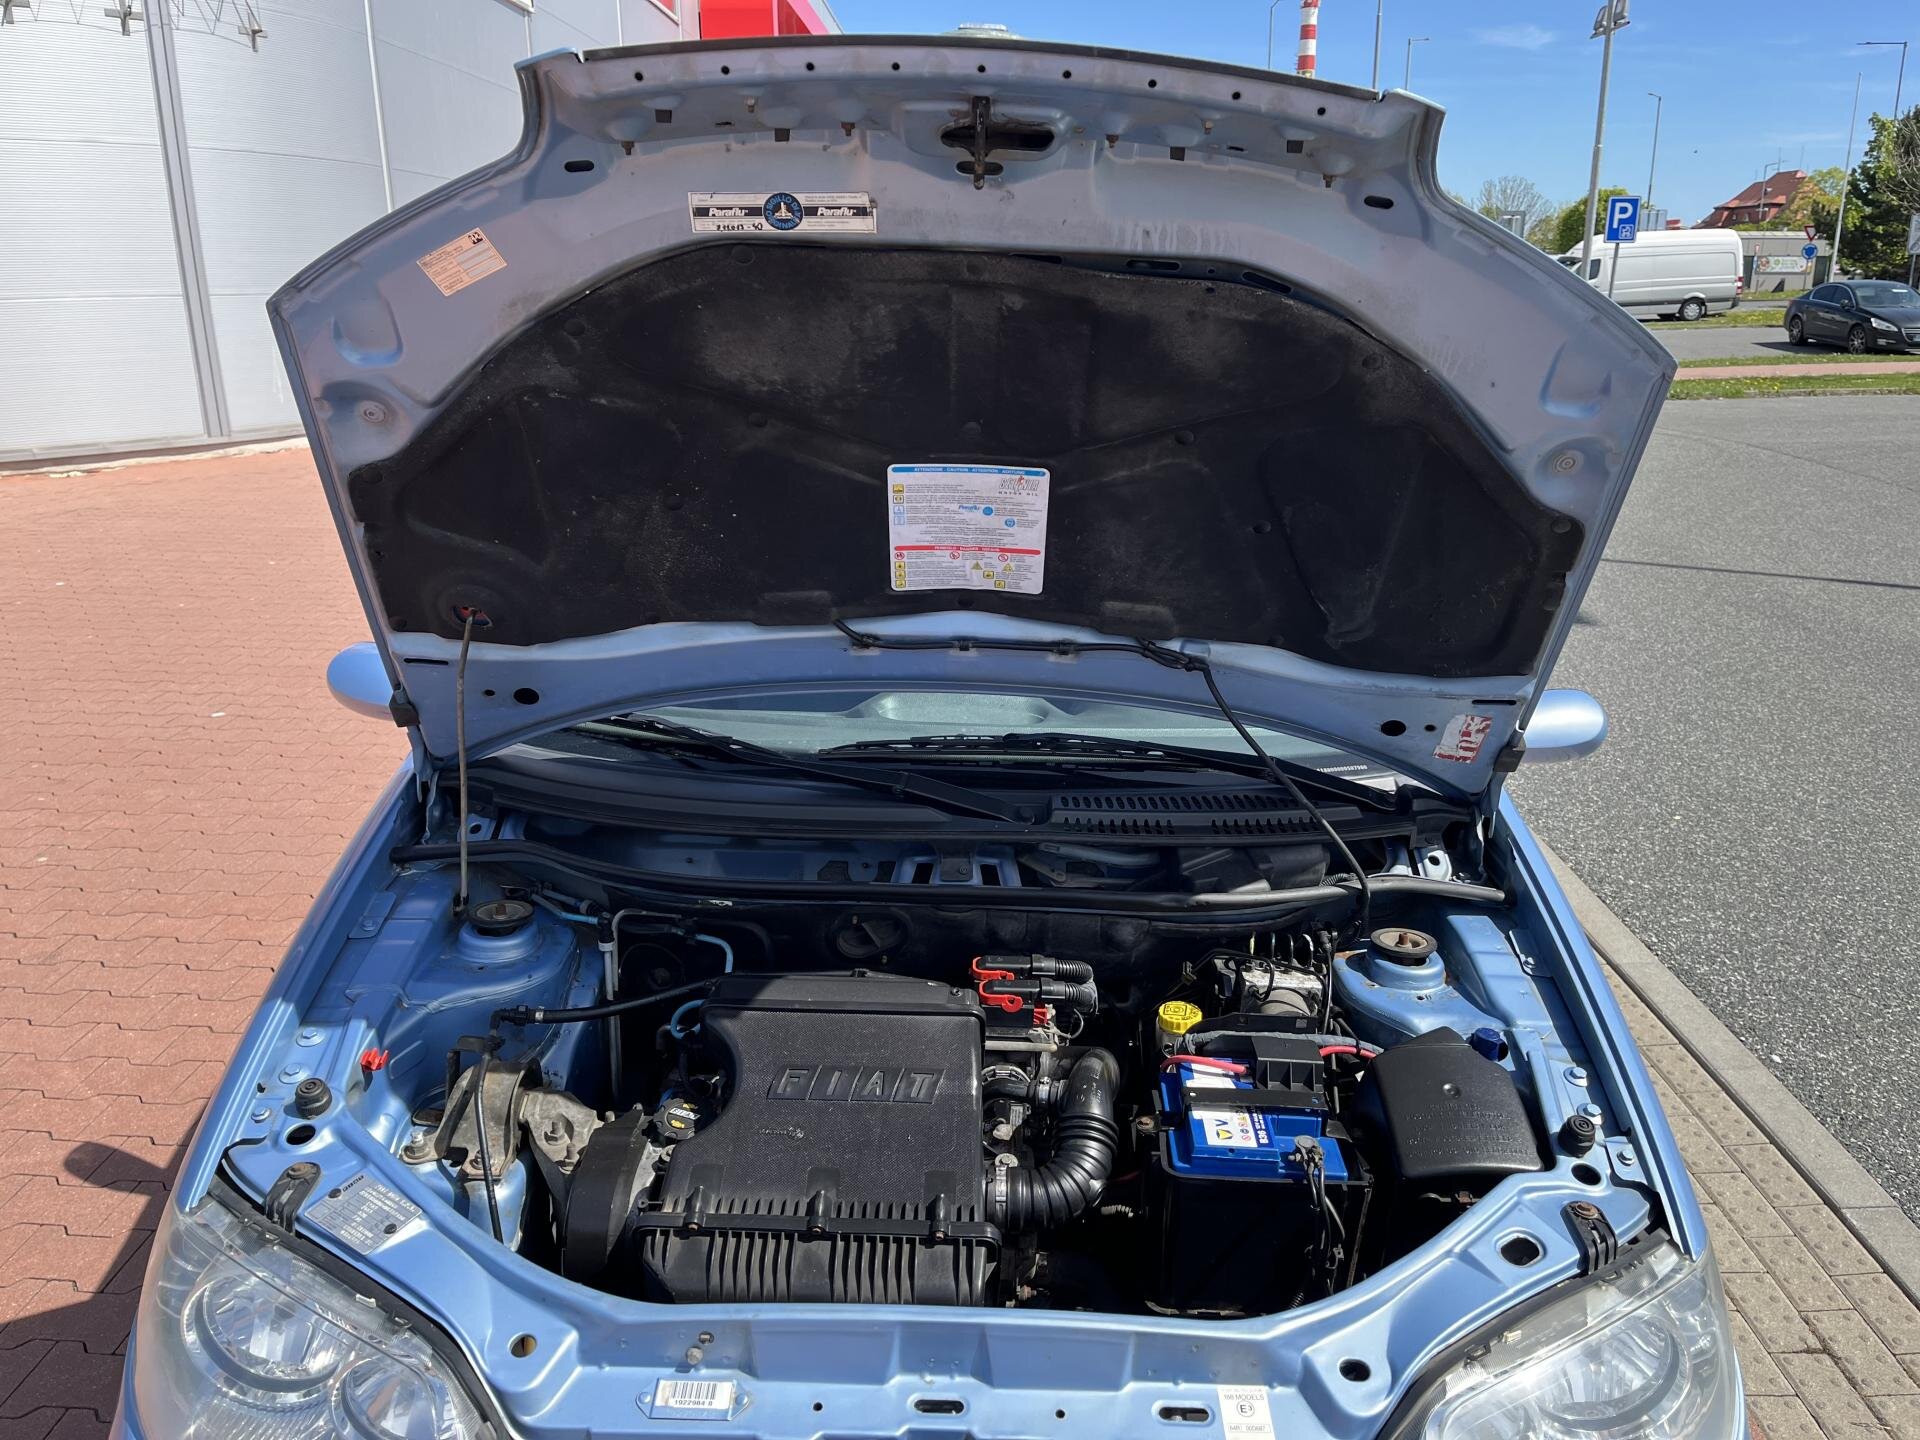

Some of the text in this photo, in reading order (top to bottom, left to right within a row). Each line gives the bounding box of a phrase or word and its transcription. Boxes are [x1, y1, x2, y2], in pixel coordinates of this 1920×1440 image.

[708, 207, 745, 217] Paraflu
[817, 207, 853, 217] Paraflu
[1612, 201, 1634, 229] P
[776, 1067, 935, 1099] FIAT
